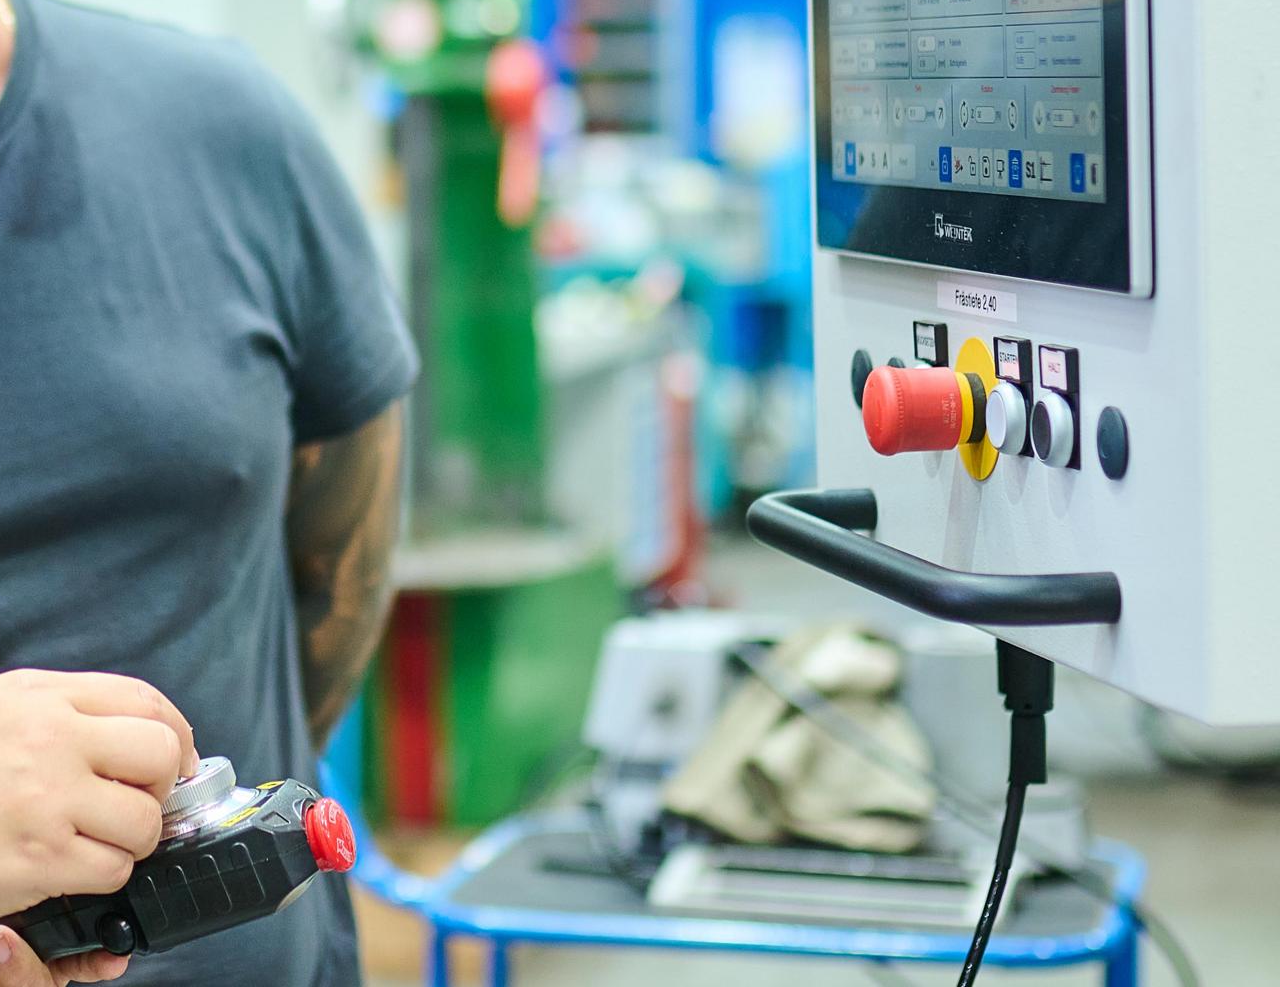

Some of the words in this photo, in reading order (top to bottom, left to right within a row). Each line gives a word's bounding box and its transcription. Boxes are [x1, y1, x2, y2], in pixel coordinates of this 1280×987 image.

[1026, 161, 1036, 179] S1
[955, 289, 981, 309] Frästiefe
[982, 294, 997, 313] 2,40
